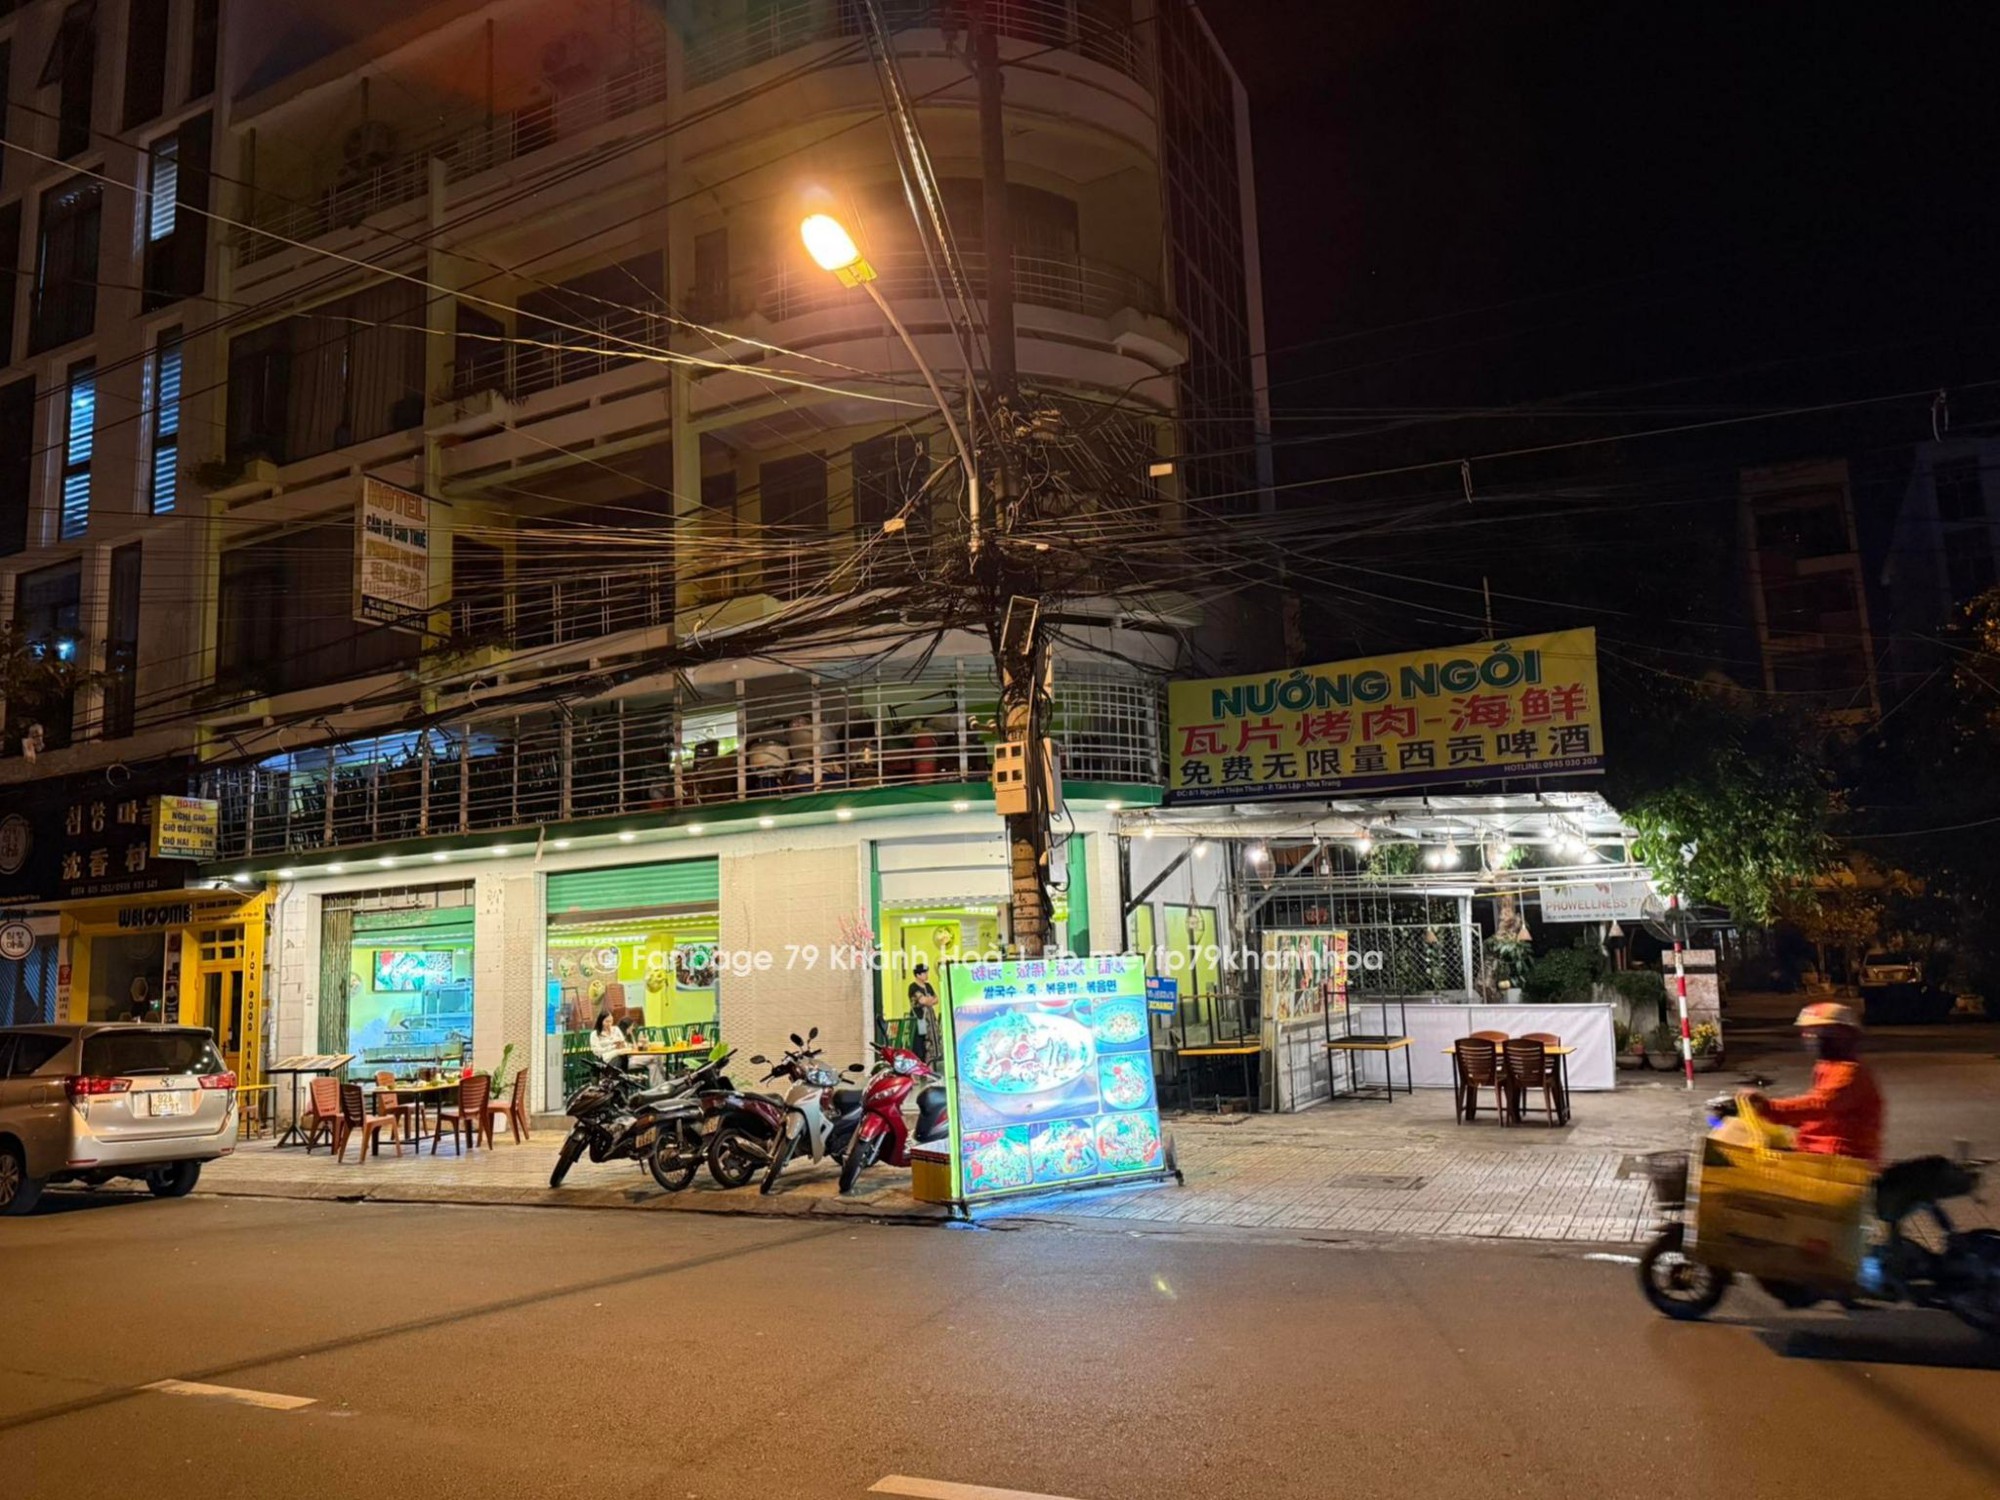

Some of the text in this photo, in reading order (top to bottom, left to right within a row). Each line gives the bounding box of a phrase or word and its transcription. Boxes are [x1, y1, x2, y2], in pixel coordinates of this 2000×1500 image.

[366, 480, 426, 522] HOTEL
[1212, 641, 1541, 720] NƯỚNG NGÓI
[1178, 683, 1588, 757] 瓦片烤肉-海鲜
[1180, 724, 1591, 786] 免费无限量西贡啤酒
[175, 799, 203, 810] HOTEL
[118, 902, 190, 928] WELCOME
